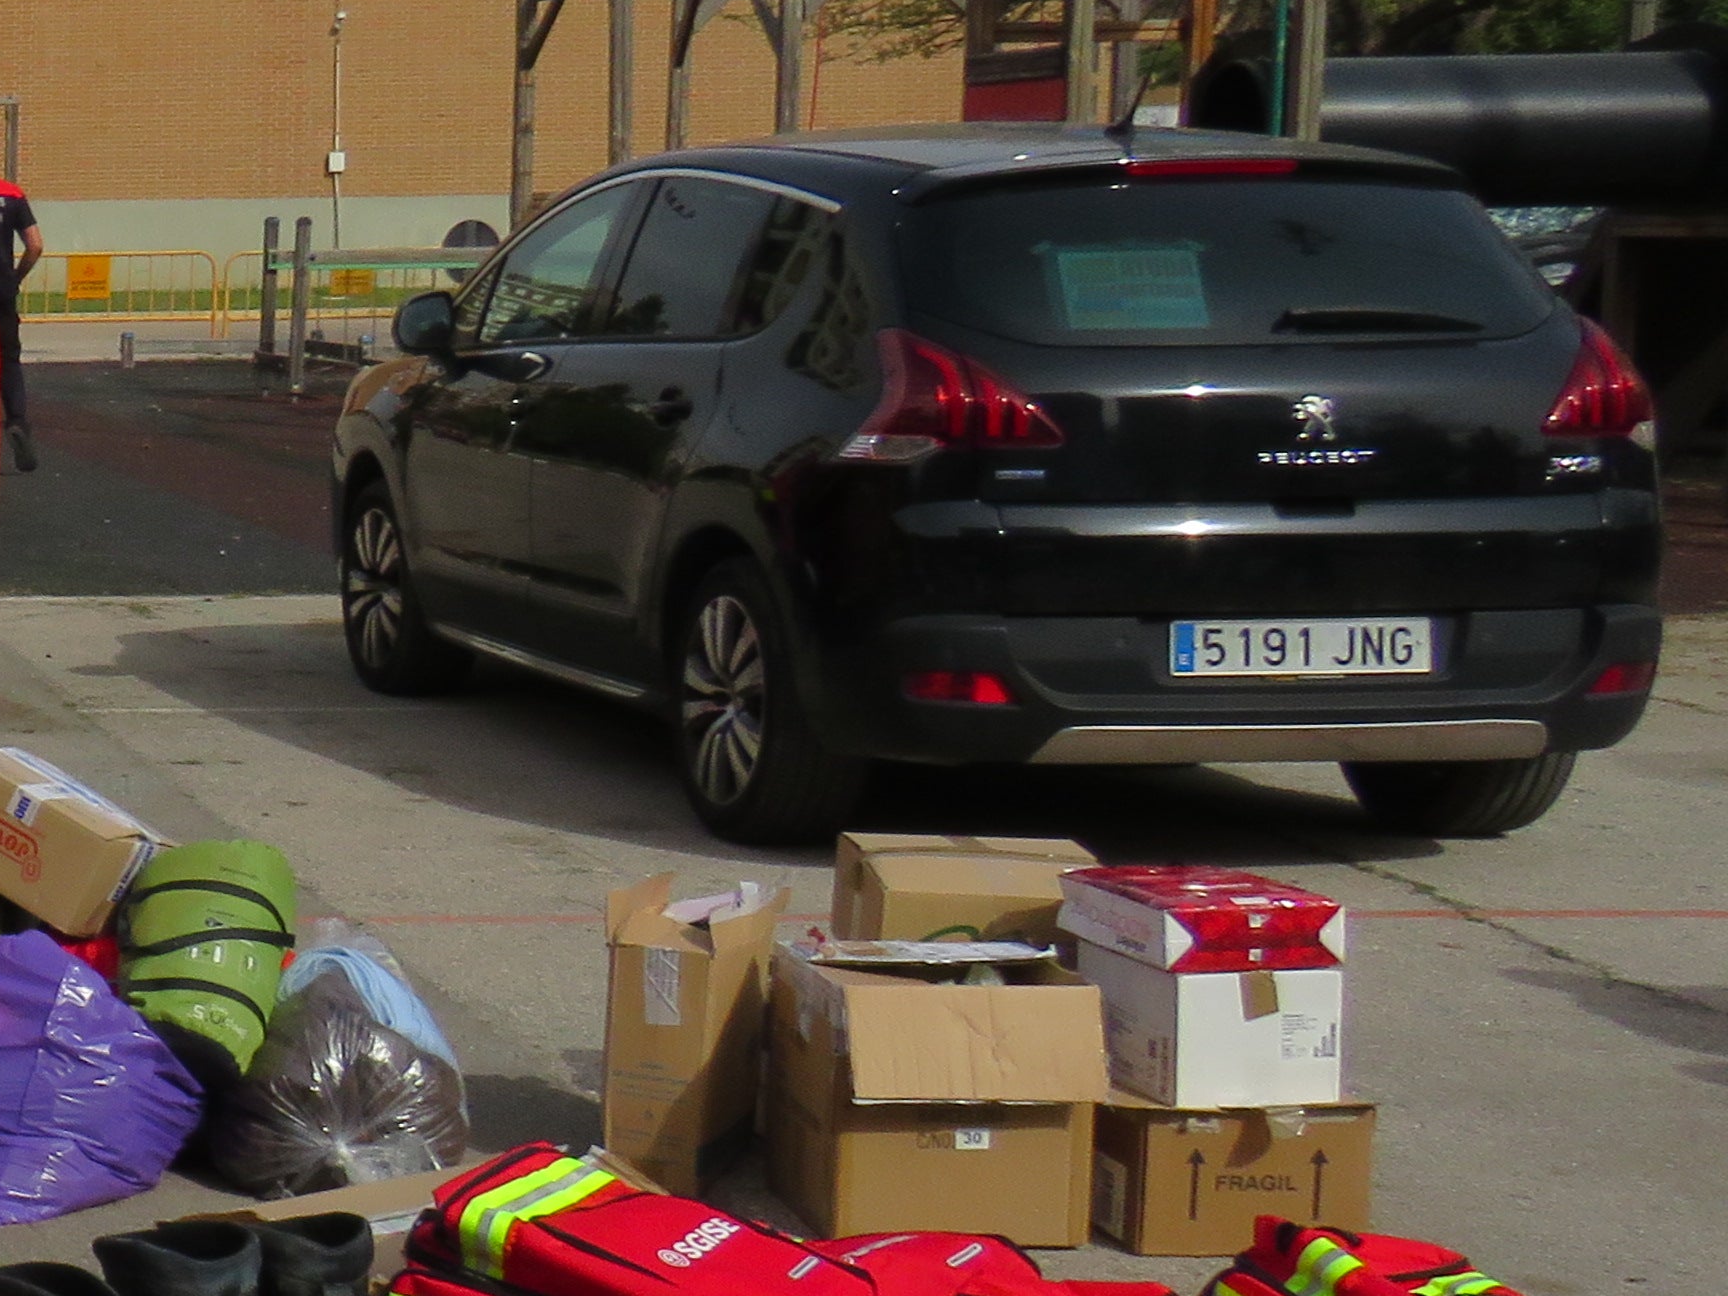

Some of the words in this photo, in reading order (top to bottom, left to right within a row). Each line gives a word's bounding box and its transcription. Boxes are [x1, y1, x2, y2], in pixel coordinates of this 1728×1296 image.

[1201, 627, 1313, 667] 5191
[1331, 626, 1414, 665] JNG
[962, 1132, 983, 1146] 30
[1215, 1174, 1299, 1193] FRAGIL
[673, 1217, 741, 1259] SGISE
